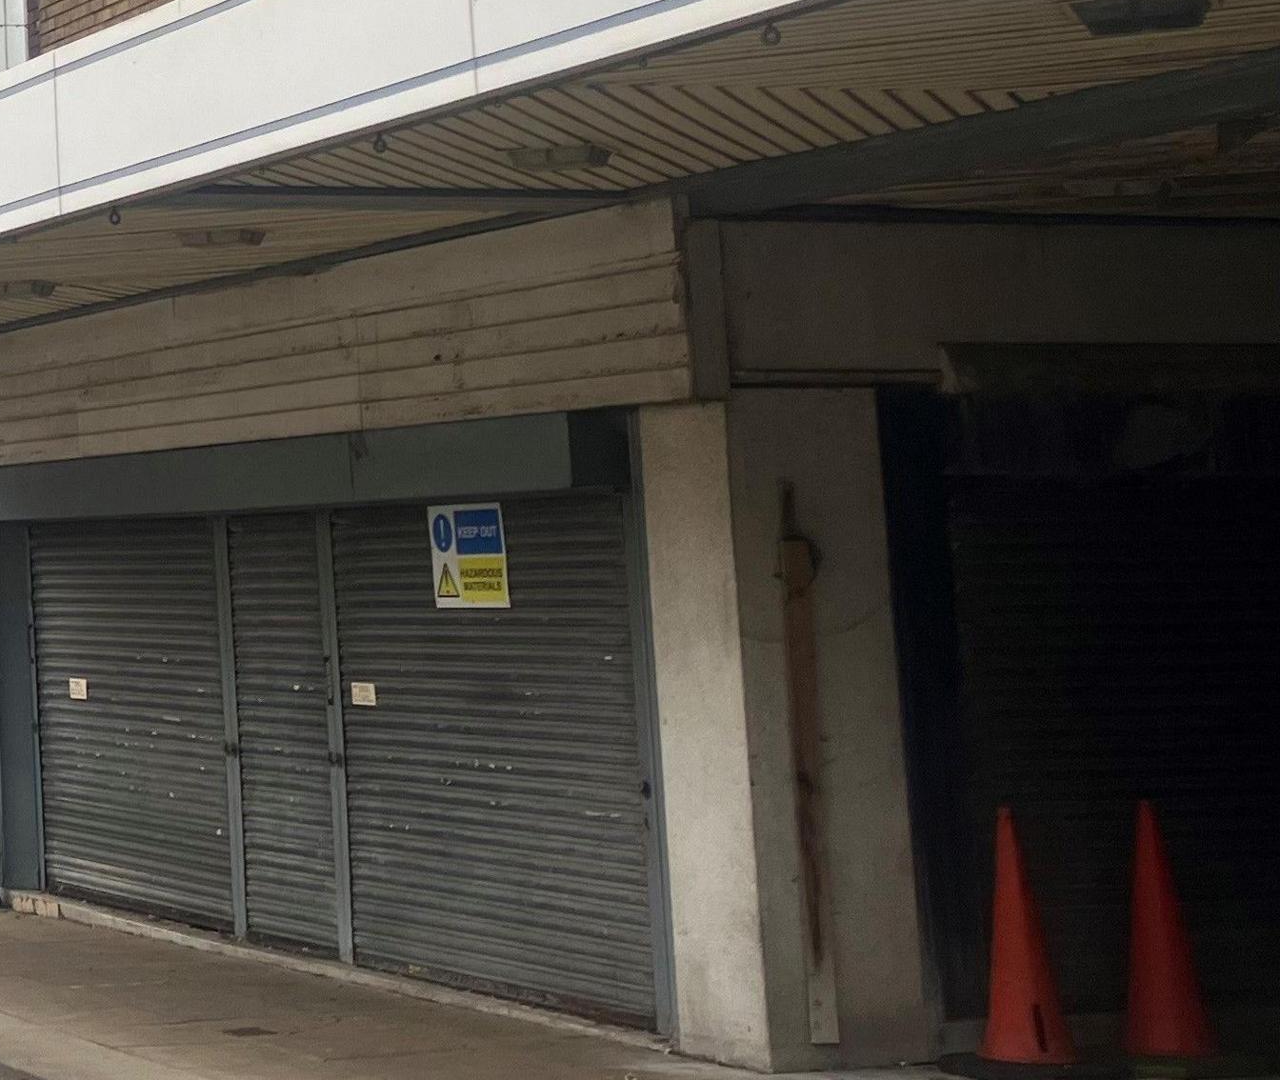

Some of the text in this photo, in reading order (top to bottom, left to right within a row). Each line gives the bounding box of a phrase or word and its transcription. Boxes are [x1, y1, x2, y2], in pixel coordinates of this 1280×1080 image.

[458, 525, 498, 539] KEEP OUT
[460, 568, 503, 578] HAZARDOUS
